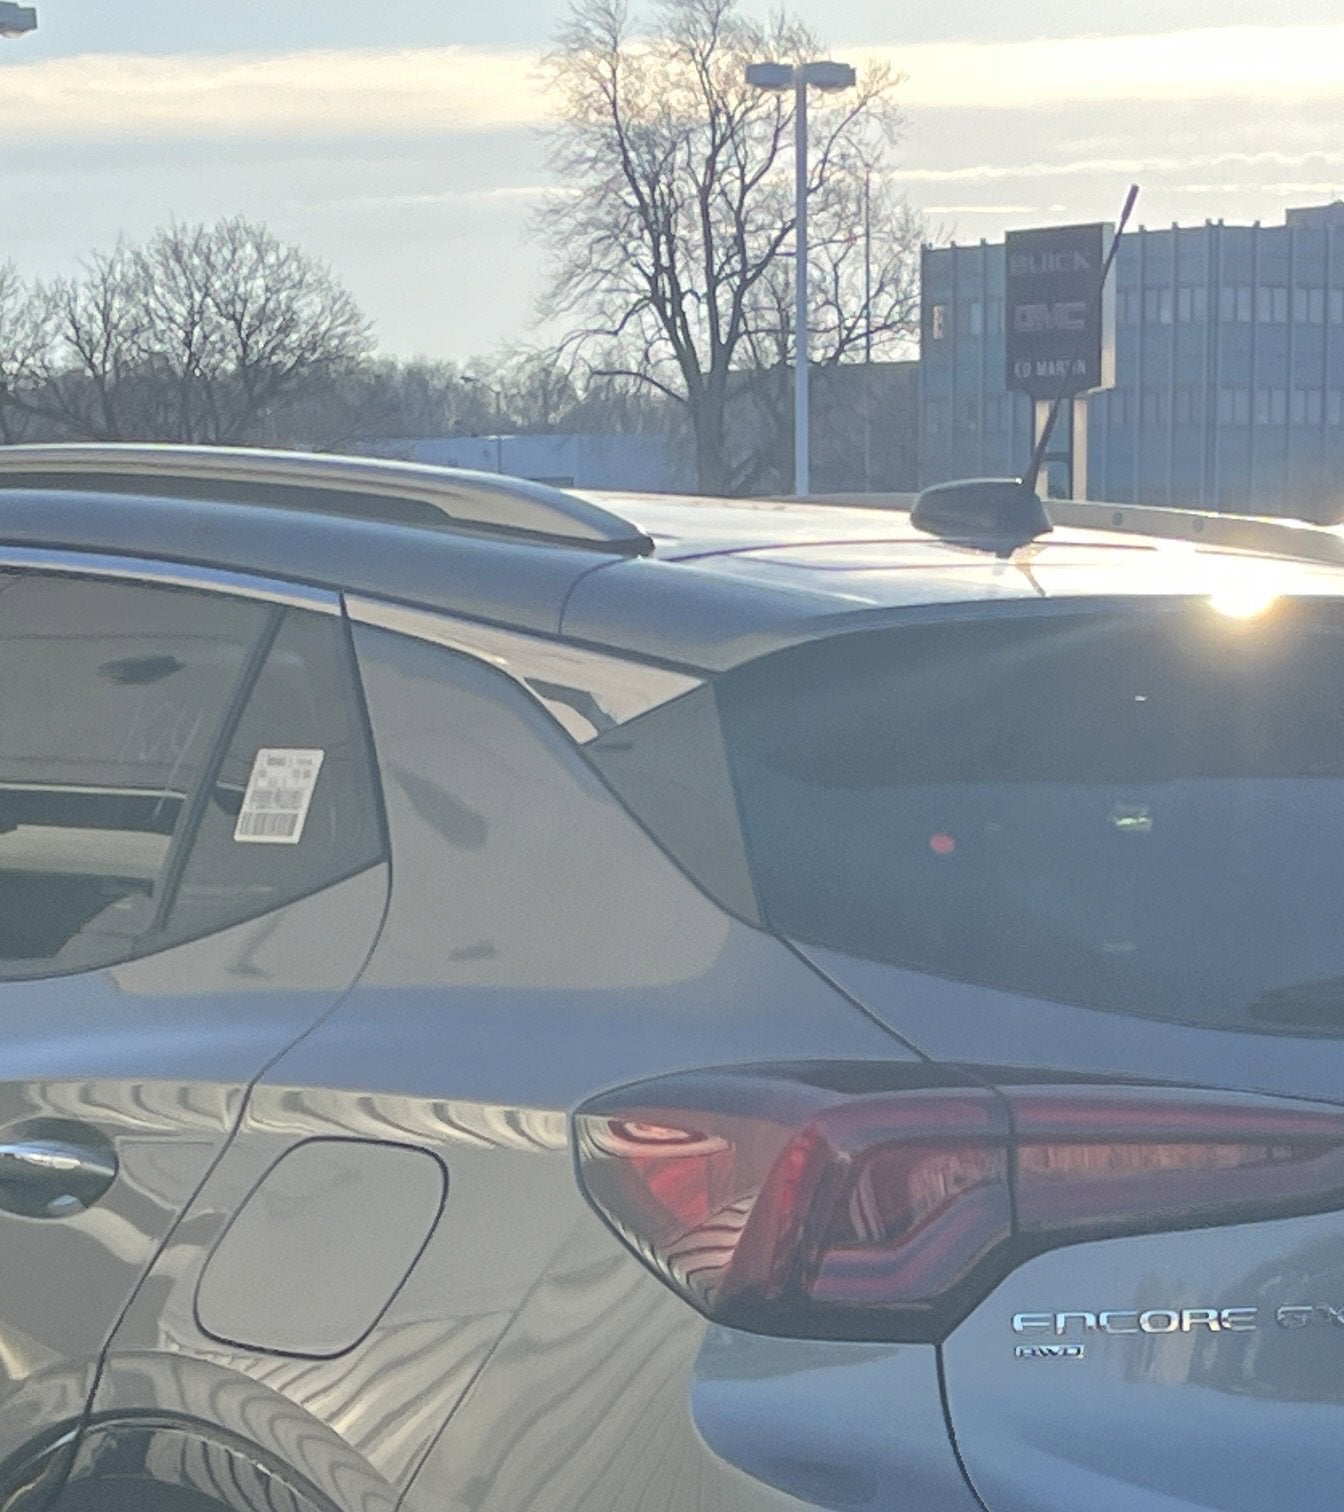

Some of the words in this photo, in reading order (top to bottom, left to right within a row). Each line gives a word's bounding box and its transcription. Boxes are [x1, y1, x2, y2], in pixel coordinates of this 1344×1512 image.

[1010, 252, 1090, 273] BUICK
[1015, 302, 1087, 331] GMC
[1014, 361, 1032, 378] ED
[1013, 1307, 1257, 1335] ENCORE
[1015, 1343, 1086, 1360] AWD
